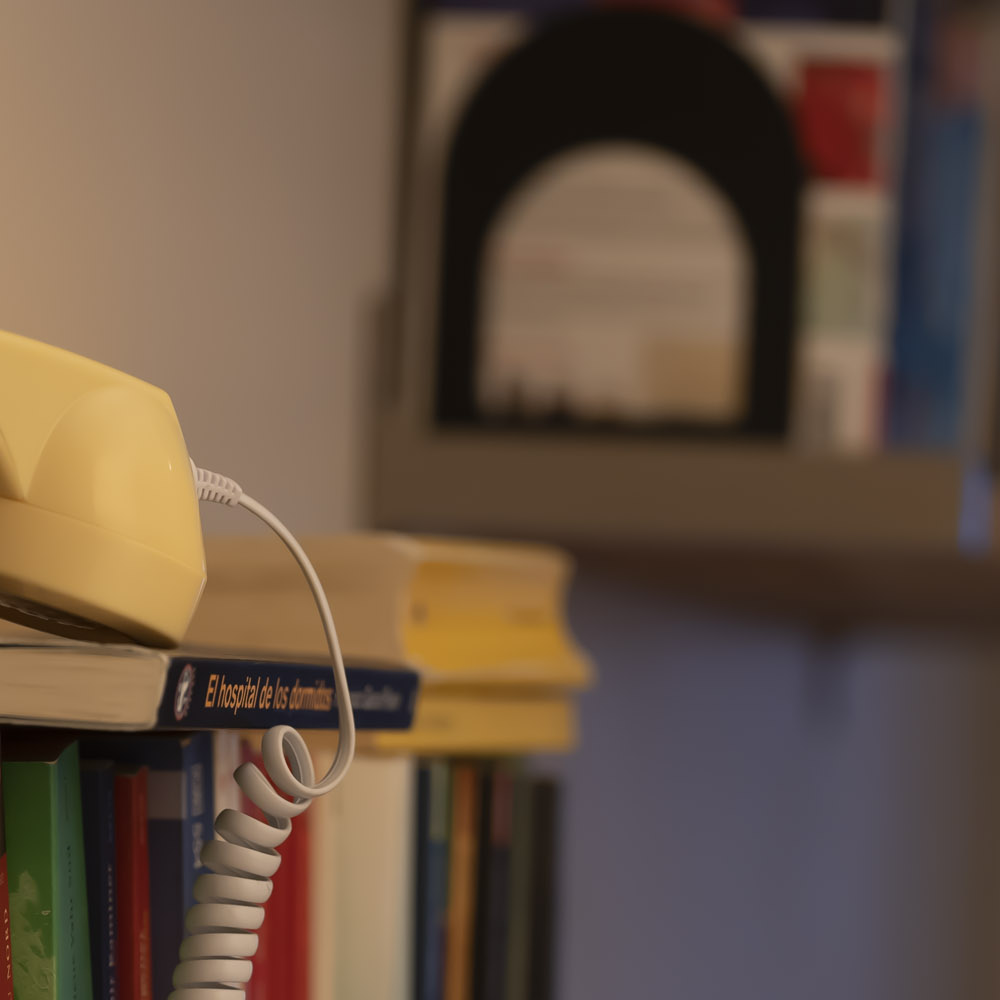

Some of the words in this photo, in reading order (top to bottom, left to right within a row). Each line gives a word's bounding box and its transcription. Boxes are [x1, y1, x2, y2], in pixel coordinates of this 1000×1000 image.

[204, 674, 220, 708] El
[217, 675, 261, 716] hospital
[259, 677, 273, 710] de
[272, 677, 289, 710] los
[3, 908, 11, 980] NORD
